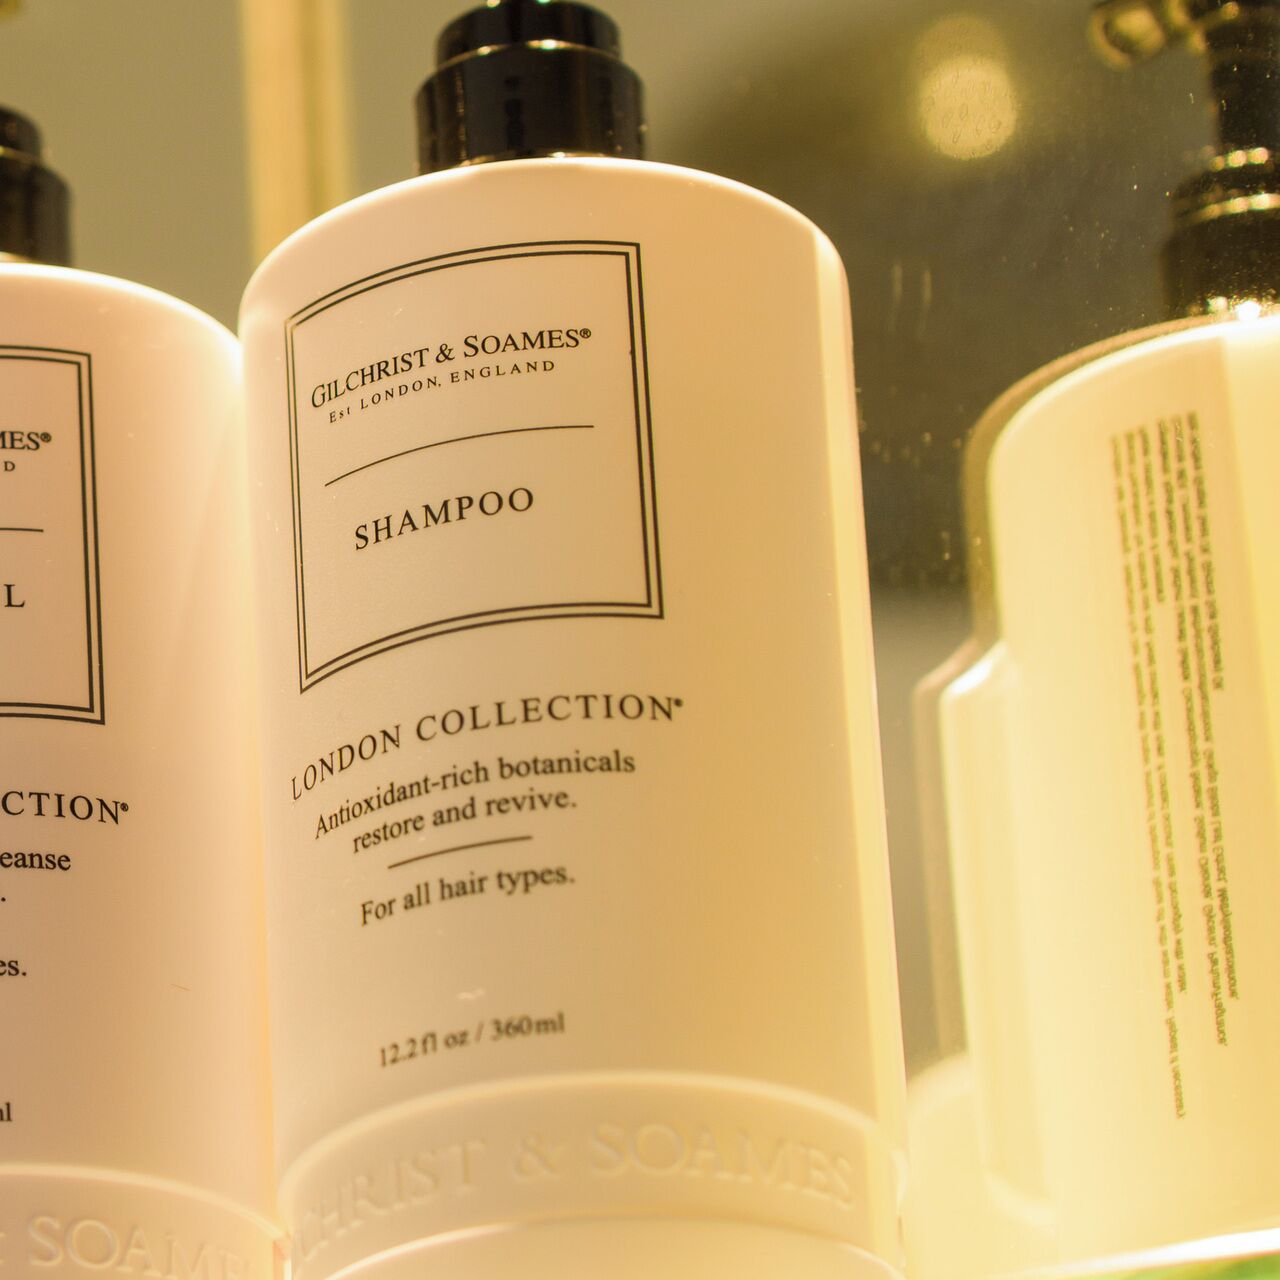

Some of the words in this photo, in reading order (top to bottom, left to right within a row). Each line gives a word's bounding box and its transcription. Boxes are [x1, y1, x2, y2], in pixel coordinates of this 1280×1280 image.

[310, 347, 430, 409] GILCHRIST
[435, 343, 455, 365] &
[328, 405, 352, 424] Est
[360, 378, 442, 410] LONDON,
[450, 359, 557, 384] ENGLAND
[354, 486, 535, 551] SHAMPOO
[290, 724, 403, 802] LONDON
[314, 758, 490, 840] Antioxidant-rich
[498, 749, 636, 782] botanicals
[351, 810, 426, 854] restore
[431, 798, 478, 827] and
[484, 788, 578, 817] revive.
[359, 896, 397, 928] For
[402, 884, 431, 910] all
[438, 872, 488, 902] hair
[496, 864, 576, 896] types.
[443, 1028, 470, 1051] oz
[474, 1020, 485, 1043] /
[512, 1129, 561, 1179] &
[586, 1122, 854, 1210] SOAMES
